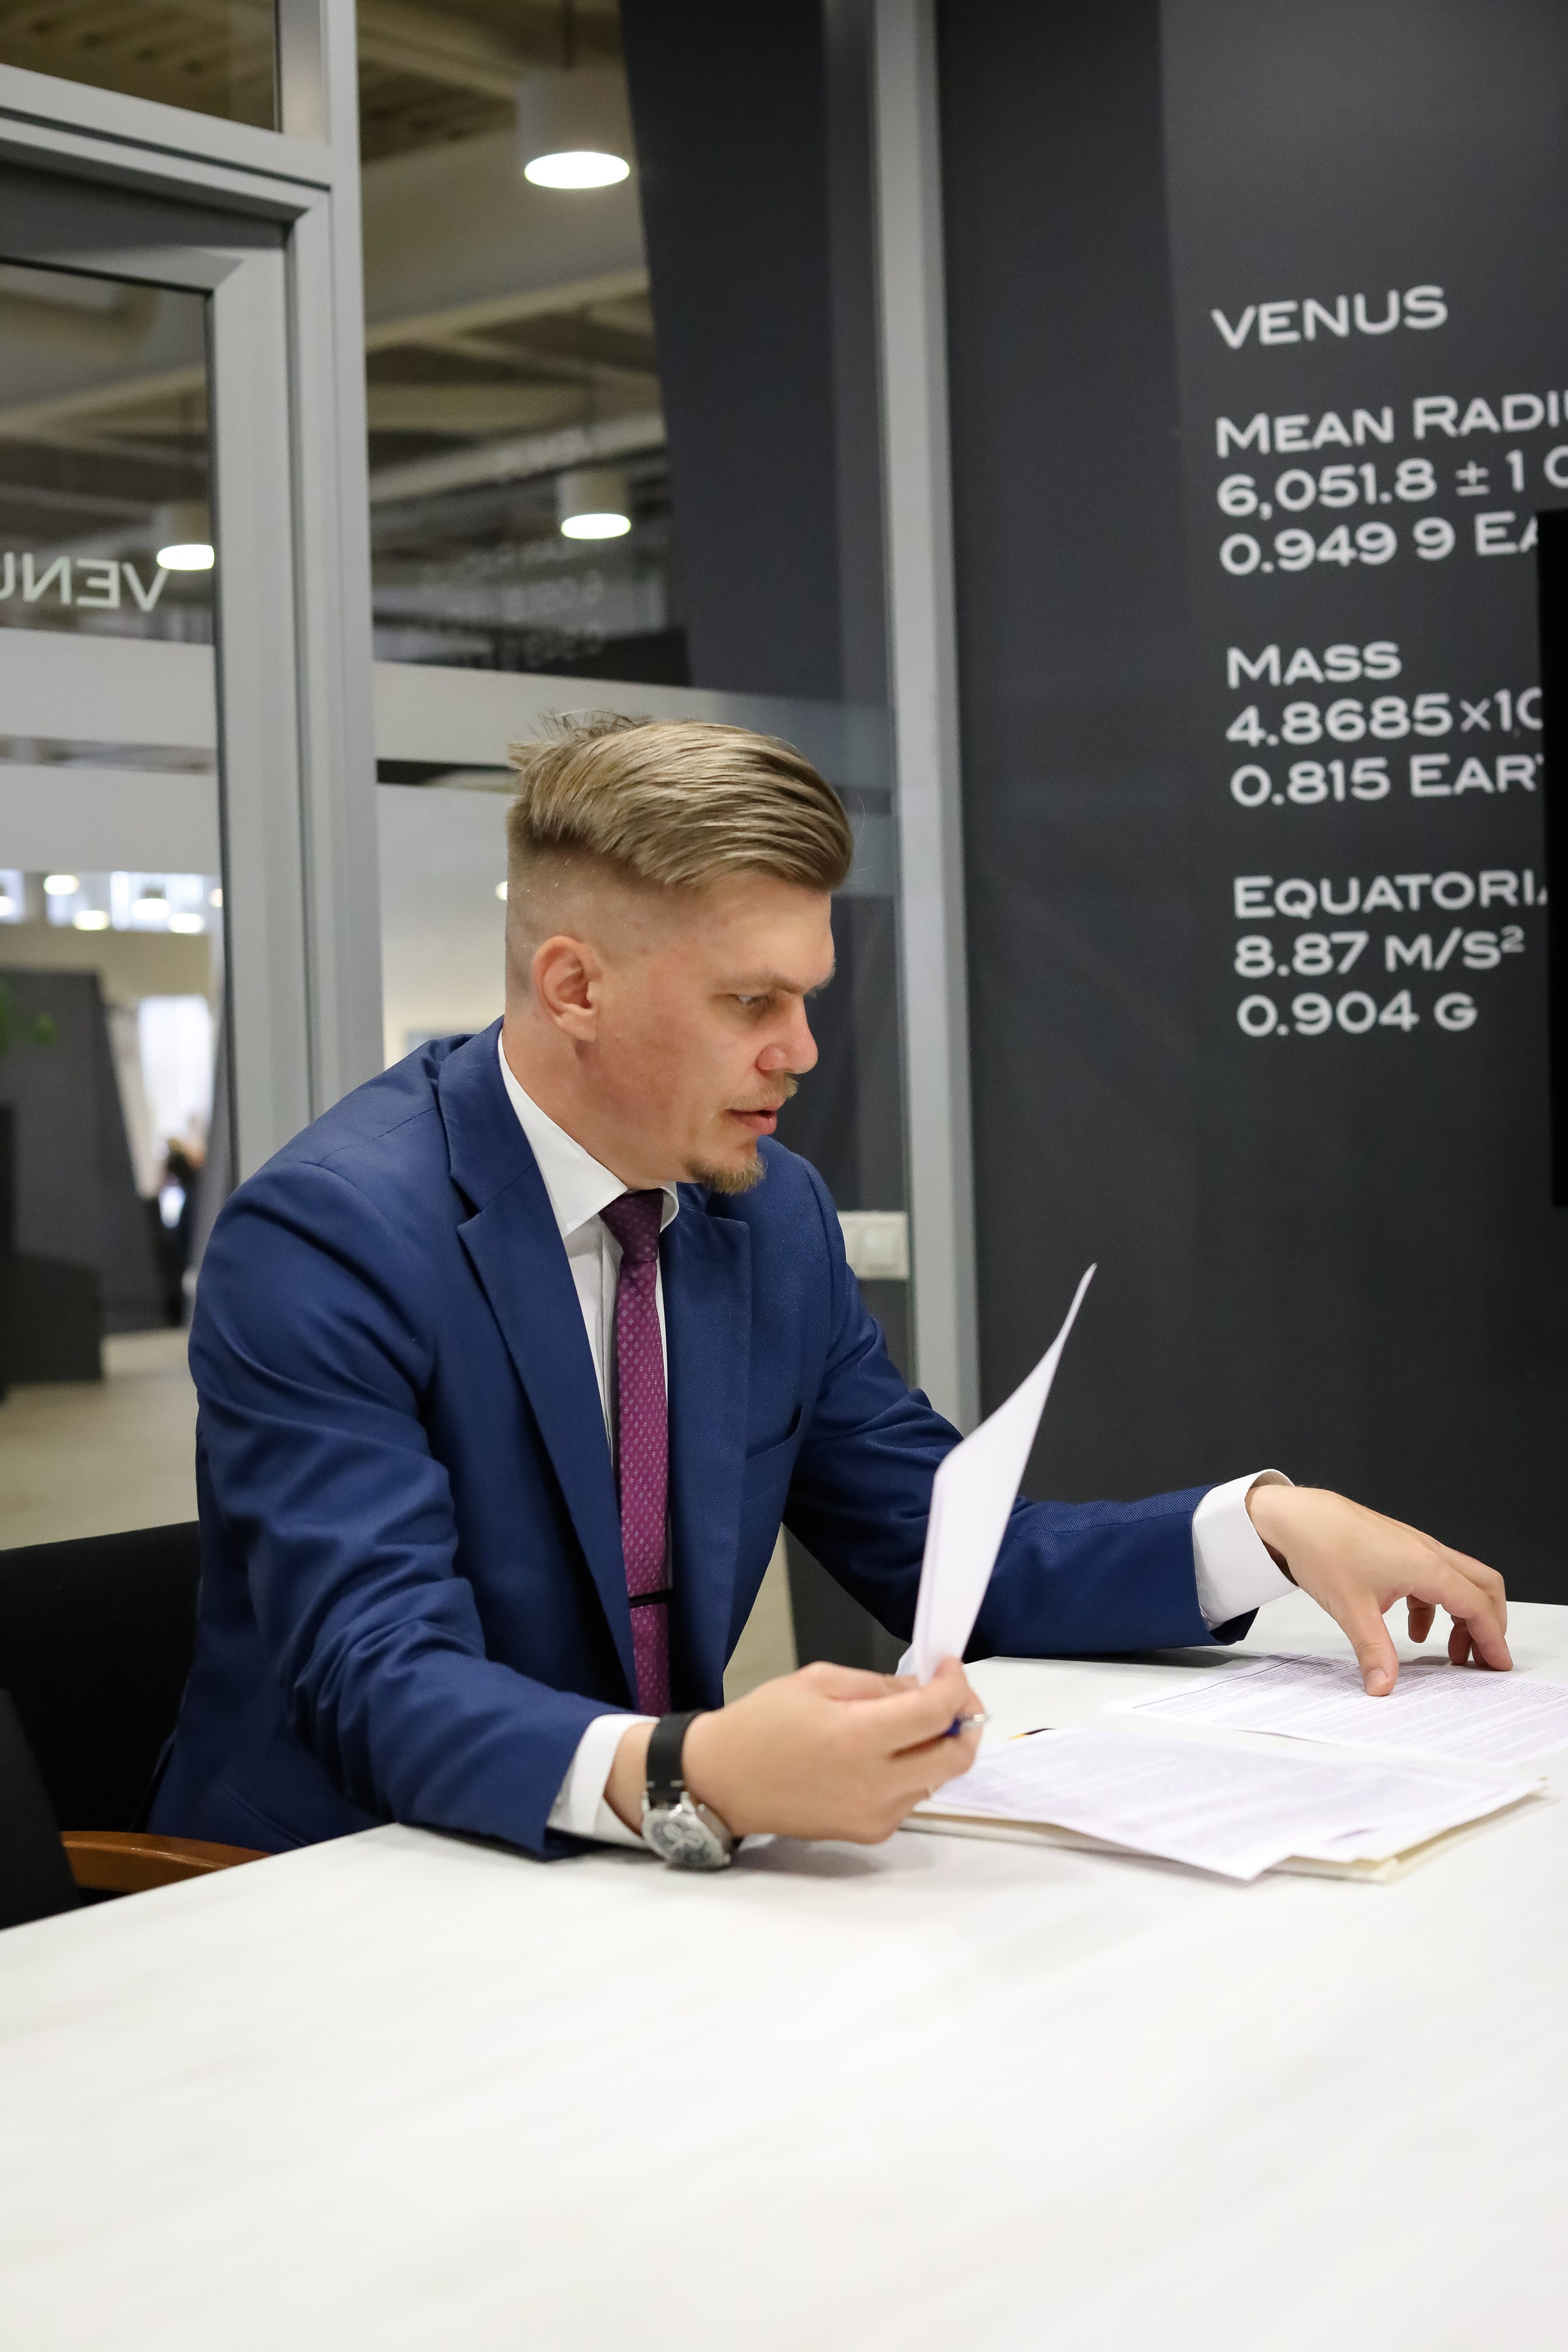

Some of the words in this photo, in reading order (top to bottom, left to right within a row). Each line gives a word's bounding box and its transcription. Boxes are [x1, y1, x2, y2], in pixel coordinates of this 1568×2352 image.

[1210, 285, 1448, 350] VENUS
[1215, 406, 1395, 459] MEAN
[1412, 390, 1568, 440] RADI
[1216, 458, 1438, 521] 6,051.8
[1506, 450, 1524, 492] 1
[1219, 521, 1398, 576] 0.949
[1412, 516, 1455, 560] 9
[1227, 641, 1402, 689] MASS
[1230, 756, 1390, 807] 0.815
[1409, 753, 1545, 797] EAR
[1234, 870, 1547, 919] EQUATORI
[1234, 931, 1369, 978] 8.87
[1237, 990, 1419, 1037] 0.904
[1434, 992, 1477, 1031] G
